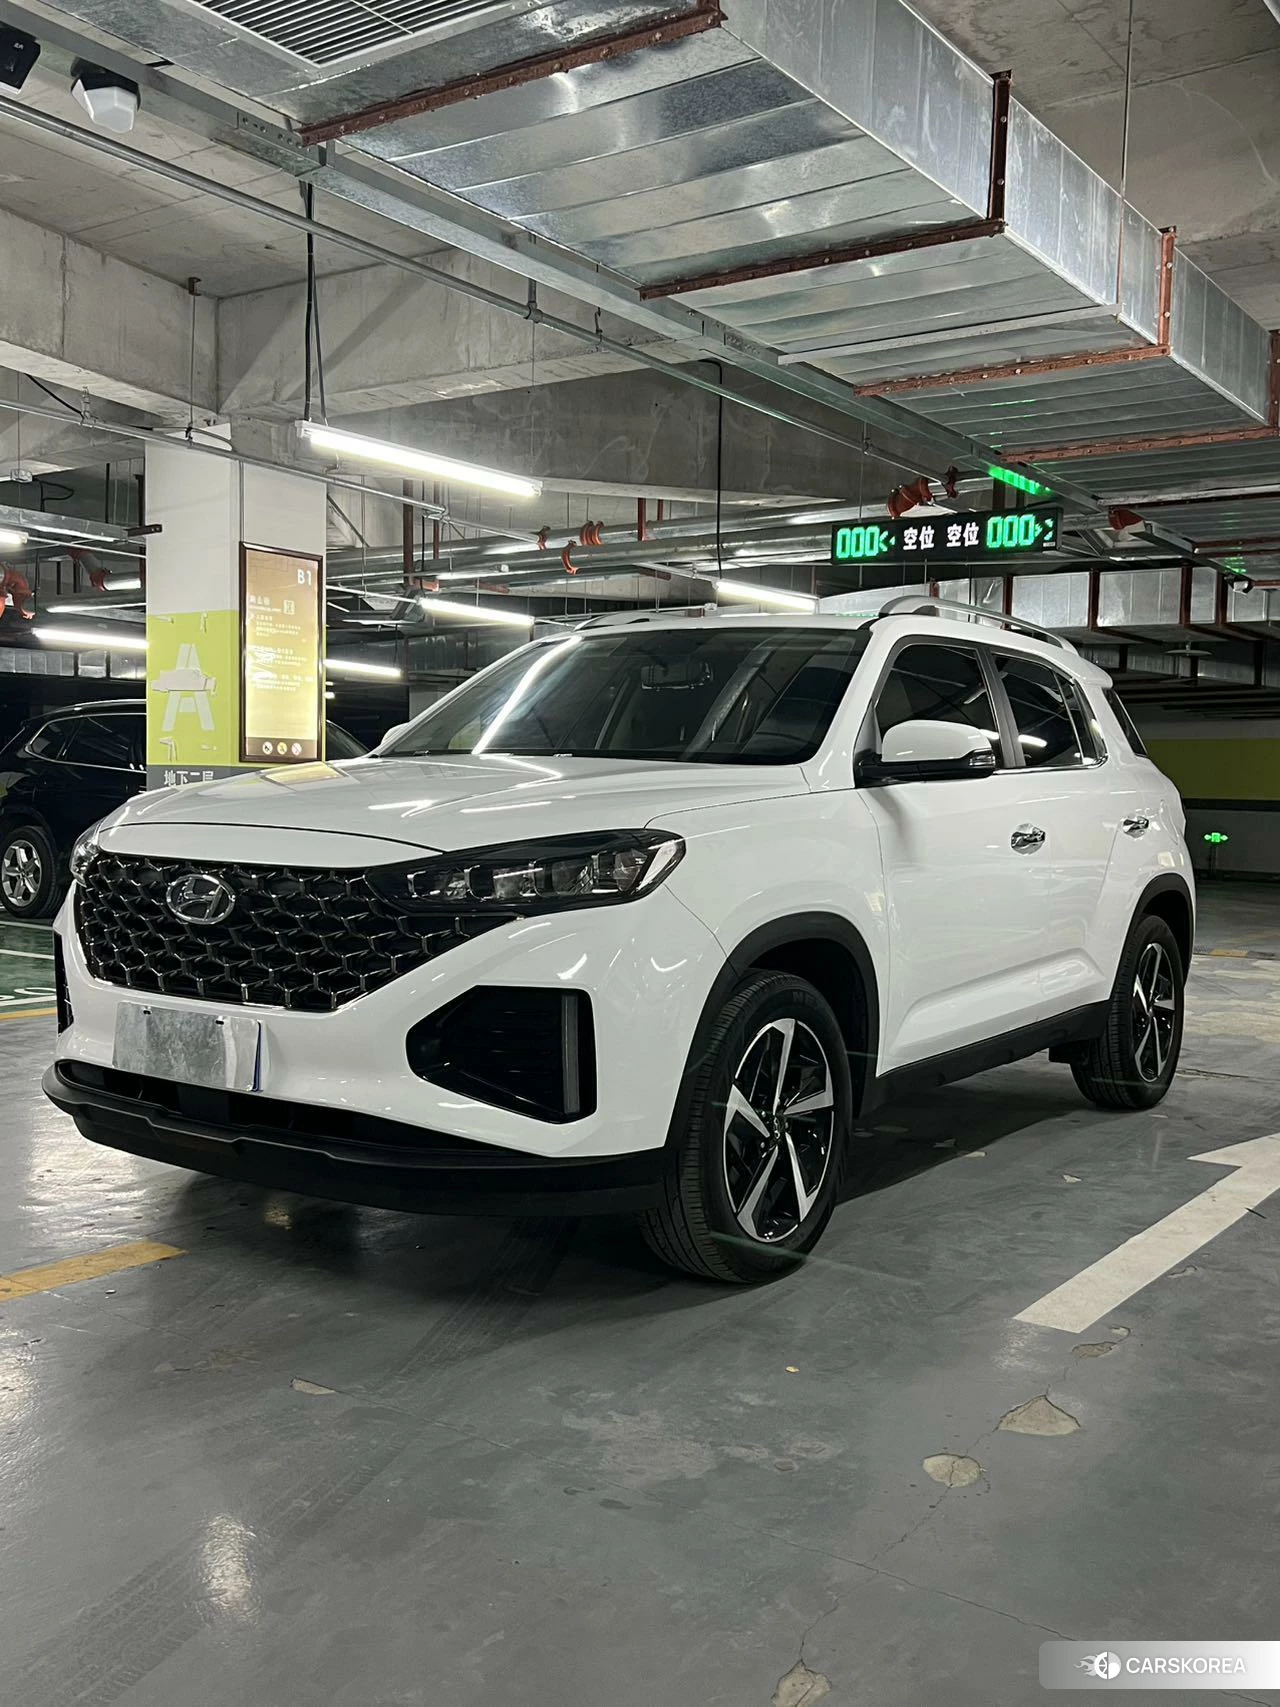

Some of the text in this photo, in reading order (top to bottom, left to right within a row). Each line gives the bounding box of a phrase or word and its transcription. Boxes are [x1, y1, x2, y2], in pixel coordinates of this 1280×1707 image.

[837, 513, 1036, 559] 000 空位 空位 000
[297, 568, 312, 586] B1
